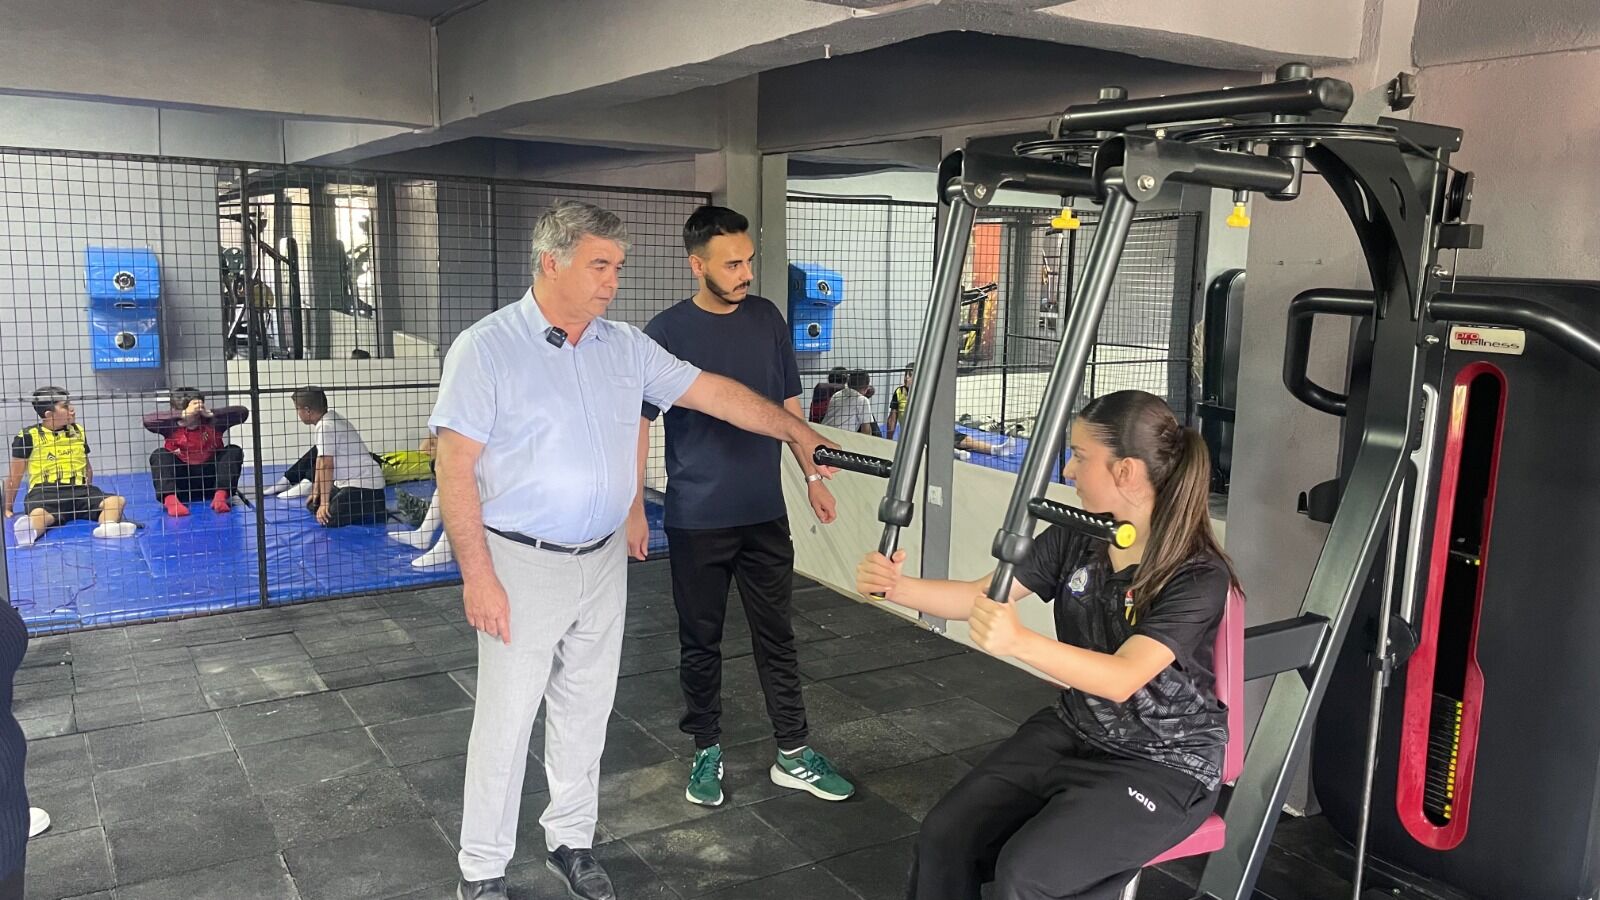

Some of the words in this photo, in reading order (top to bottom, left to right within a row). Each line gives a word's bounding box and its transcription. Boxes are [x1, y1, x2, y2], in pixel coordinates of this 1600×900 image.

[1456, 333, 1479, 341] pro
[1461, 339, 1520, 349] wellness
[1128, 787, 1156, 812] VOID
